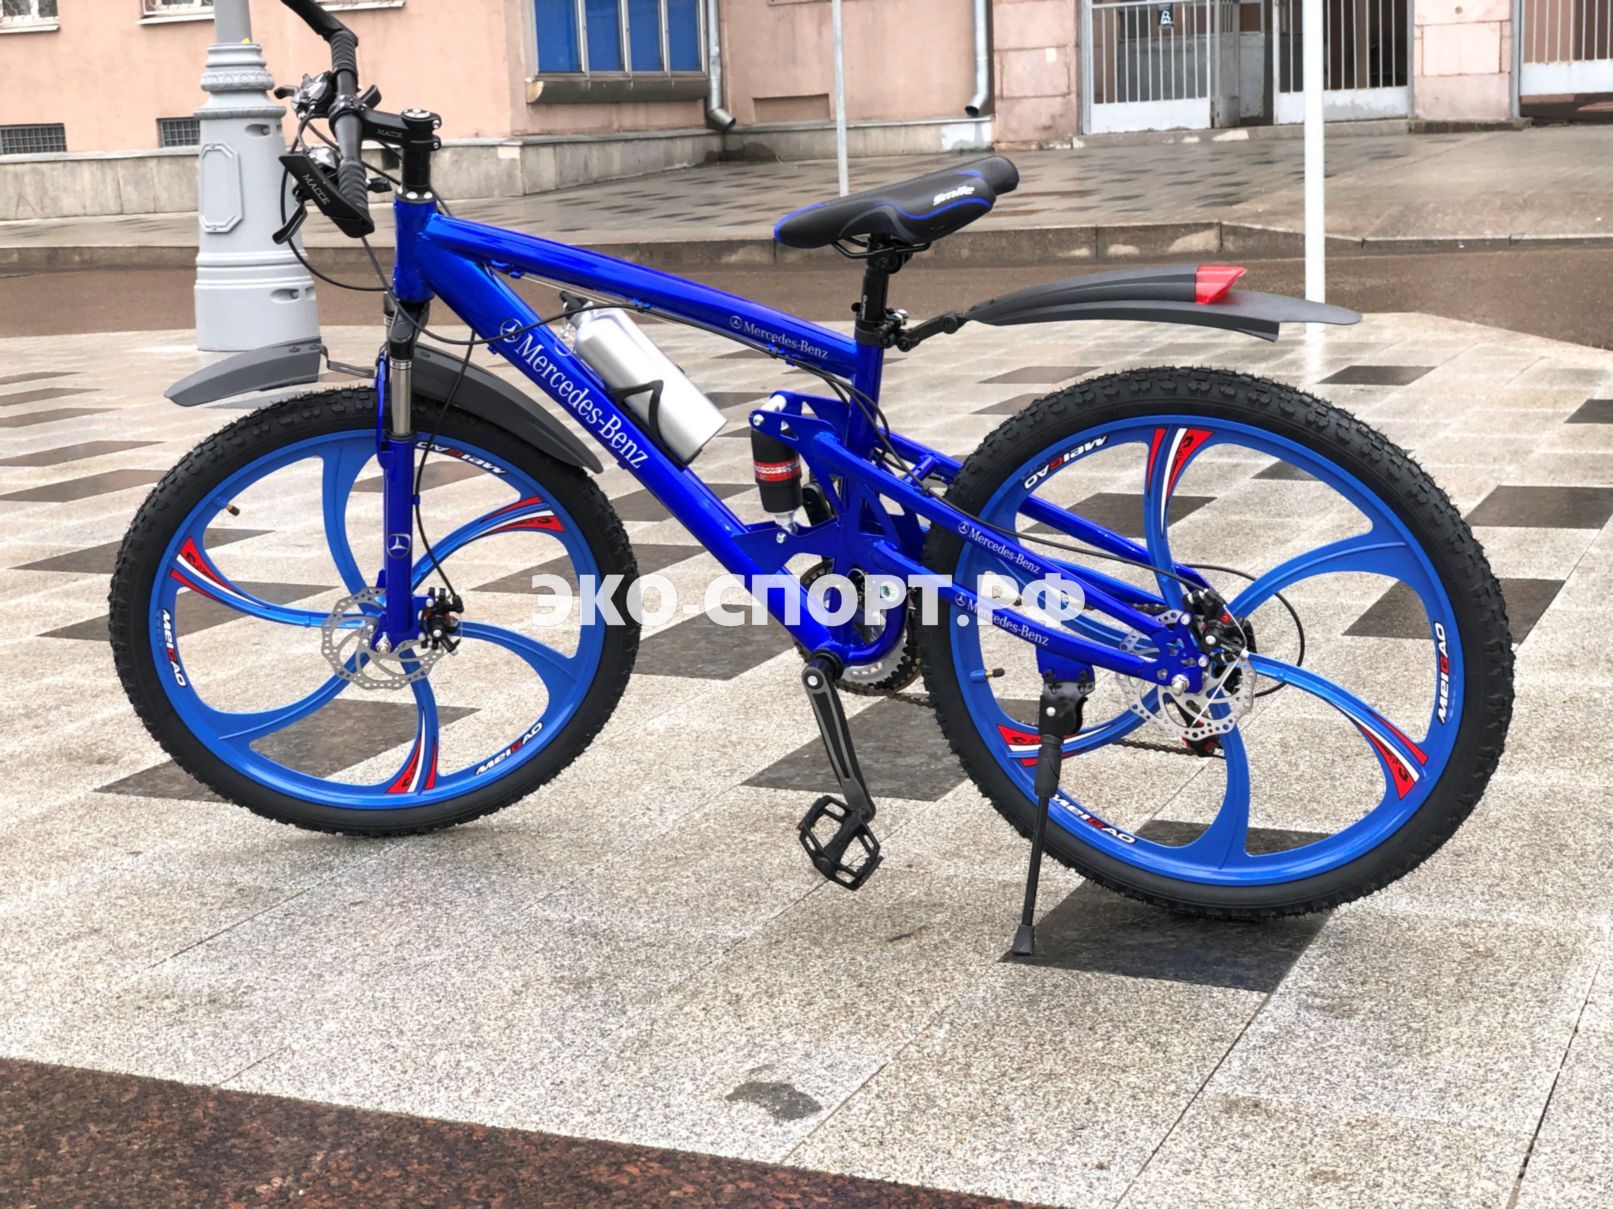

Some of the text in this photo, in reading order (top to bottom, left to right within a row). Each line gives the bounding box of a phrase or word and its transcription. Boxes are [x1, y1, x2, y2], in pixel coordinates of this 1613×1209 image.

[744, 321, 828, 360] Mercedes-Benz
[514, 333, 649, 469] Mercedes-Benz
[968, 528, 1041, 574] Mercedes-Benz
